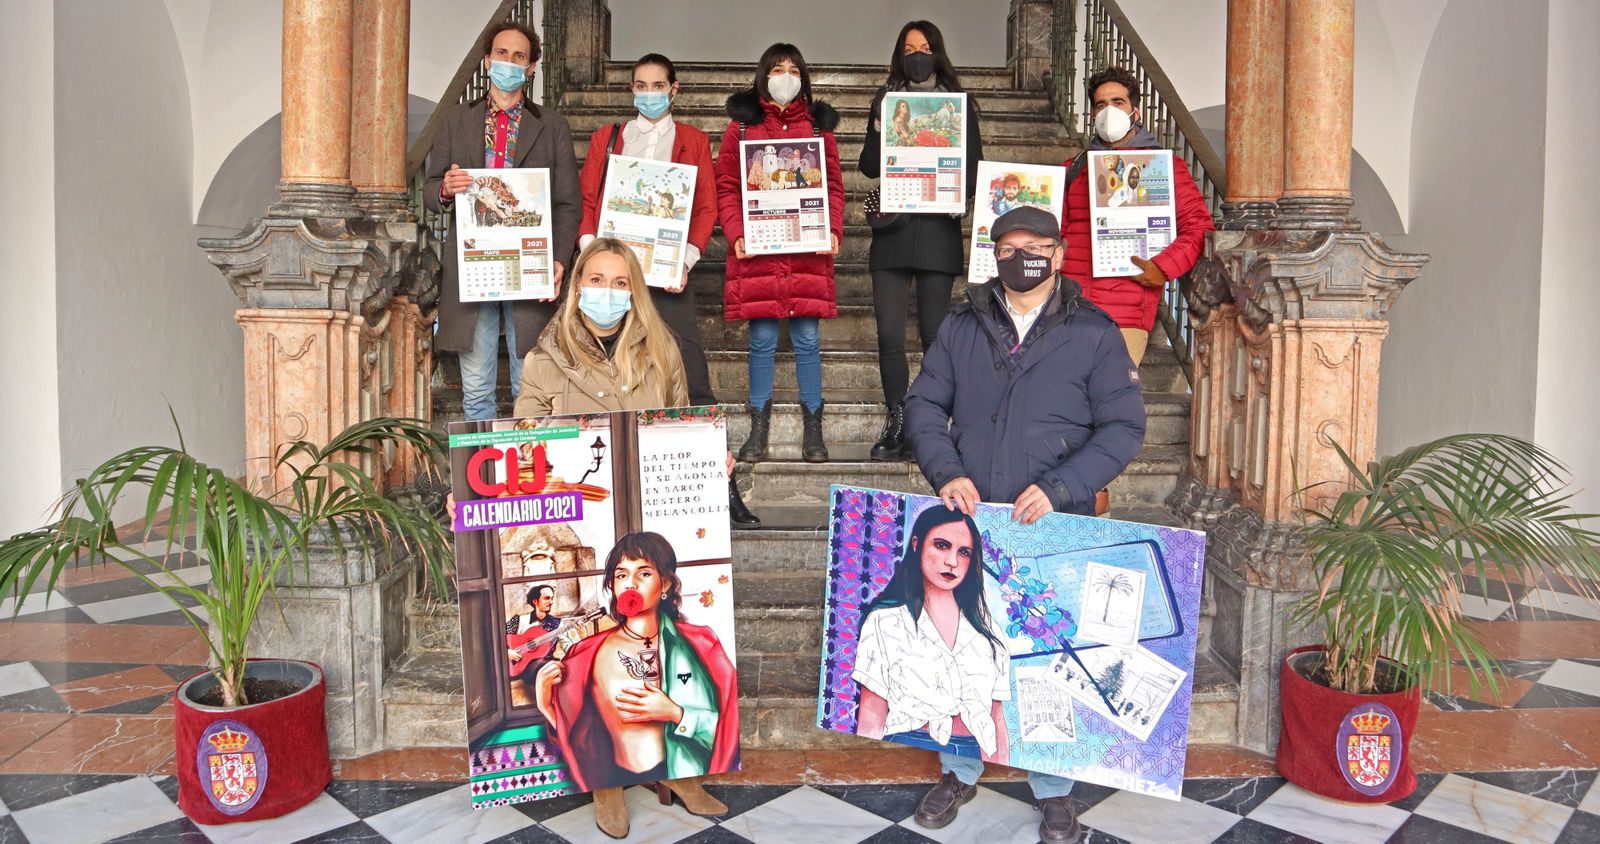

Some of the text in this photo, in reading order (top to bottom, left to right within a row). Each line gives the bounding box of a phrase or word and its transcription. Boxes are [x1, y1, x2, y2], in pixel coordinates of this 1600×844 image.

[644, 452, 691, 462] LA FLOR
[466, 445, 546, 497] CIJ
[644, 460, 716, 472] DEL TIEMPO
[665, 483, 704, 493] BARCO
[644, 496, 701, 506] AUSTERO
[463, 495, 577, 528] CALENDARIO 2021
[645, 505, 730, 518] MELANCOLIA
